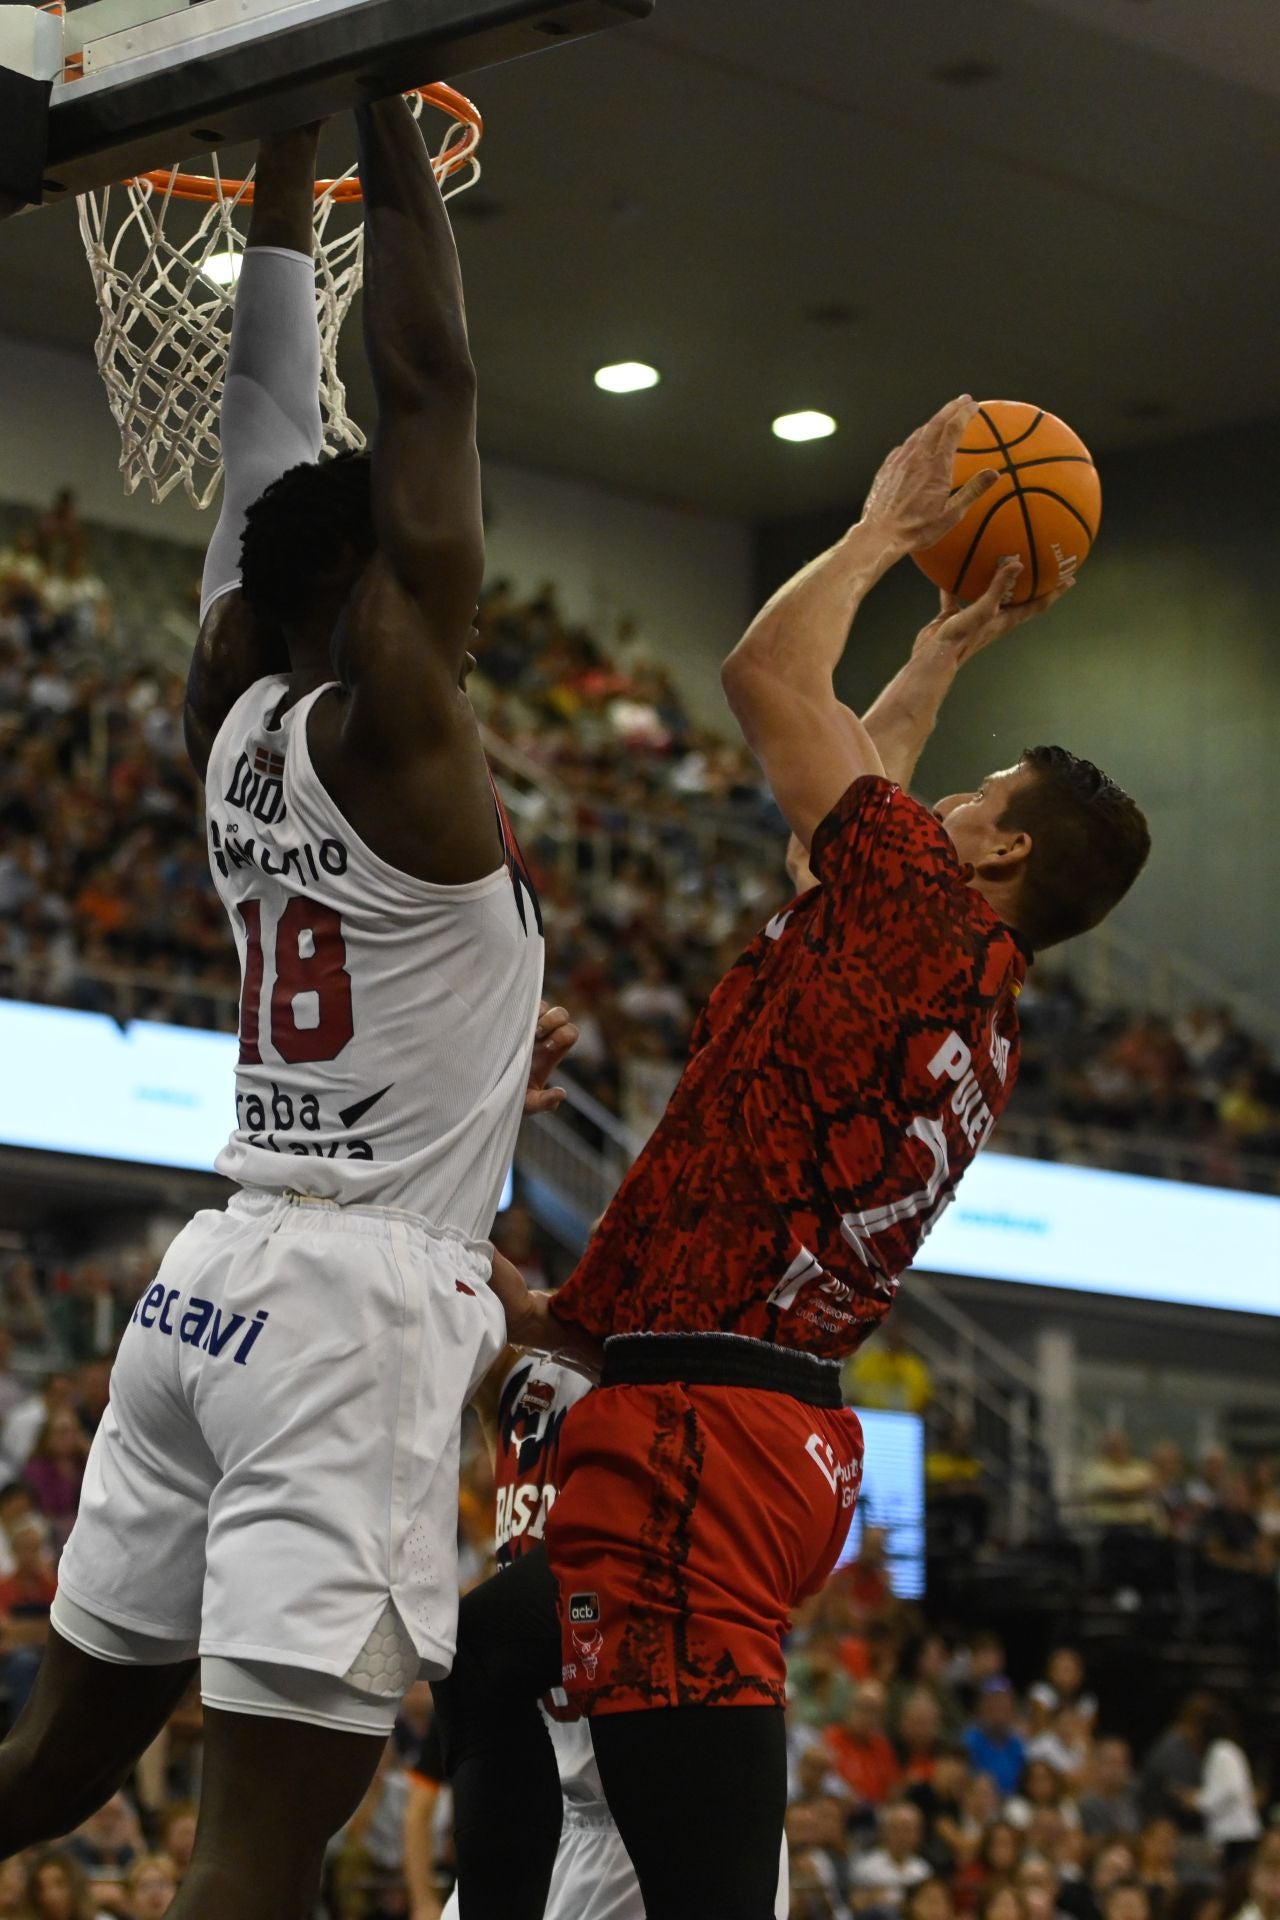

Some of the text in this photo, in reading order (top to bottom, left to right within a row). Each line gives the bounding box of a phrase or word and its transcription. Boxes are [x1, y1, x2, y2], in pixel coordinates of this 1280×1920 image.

[236, 895, 355, 1065] 18
[132, 1282, 270, 1366] ecavi
[571, 1605, 594, 1619] acb
